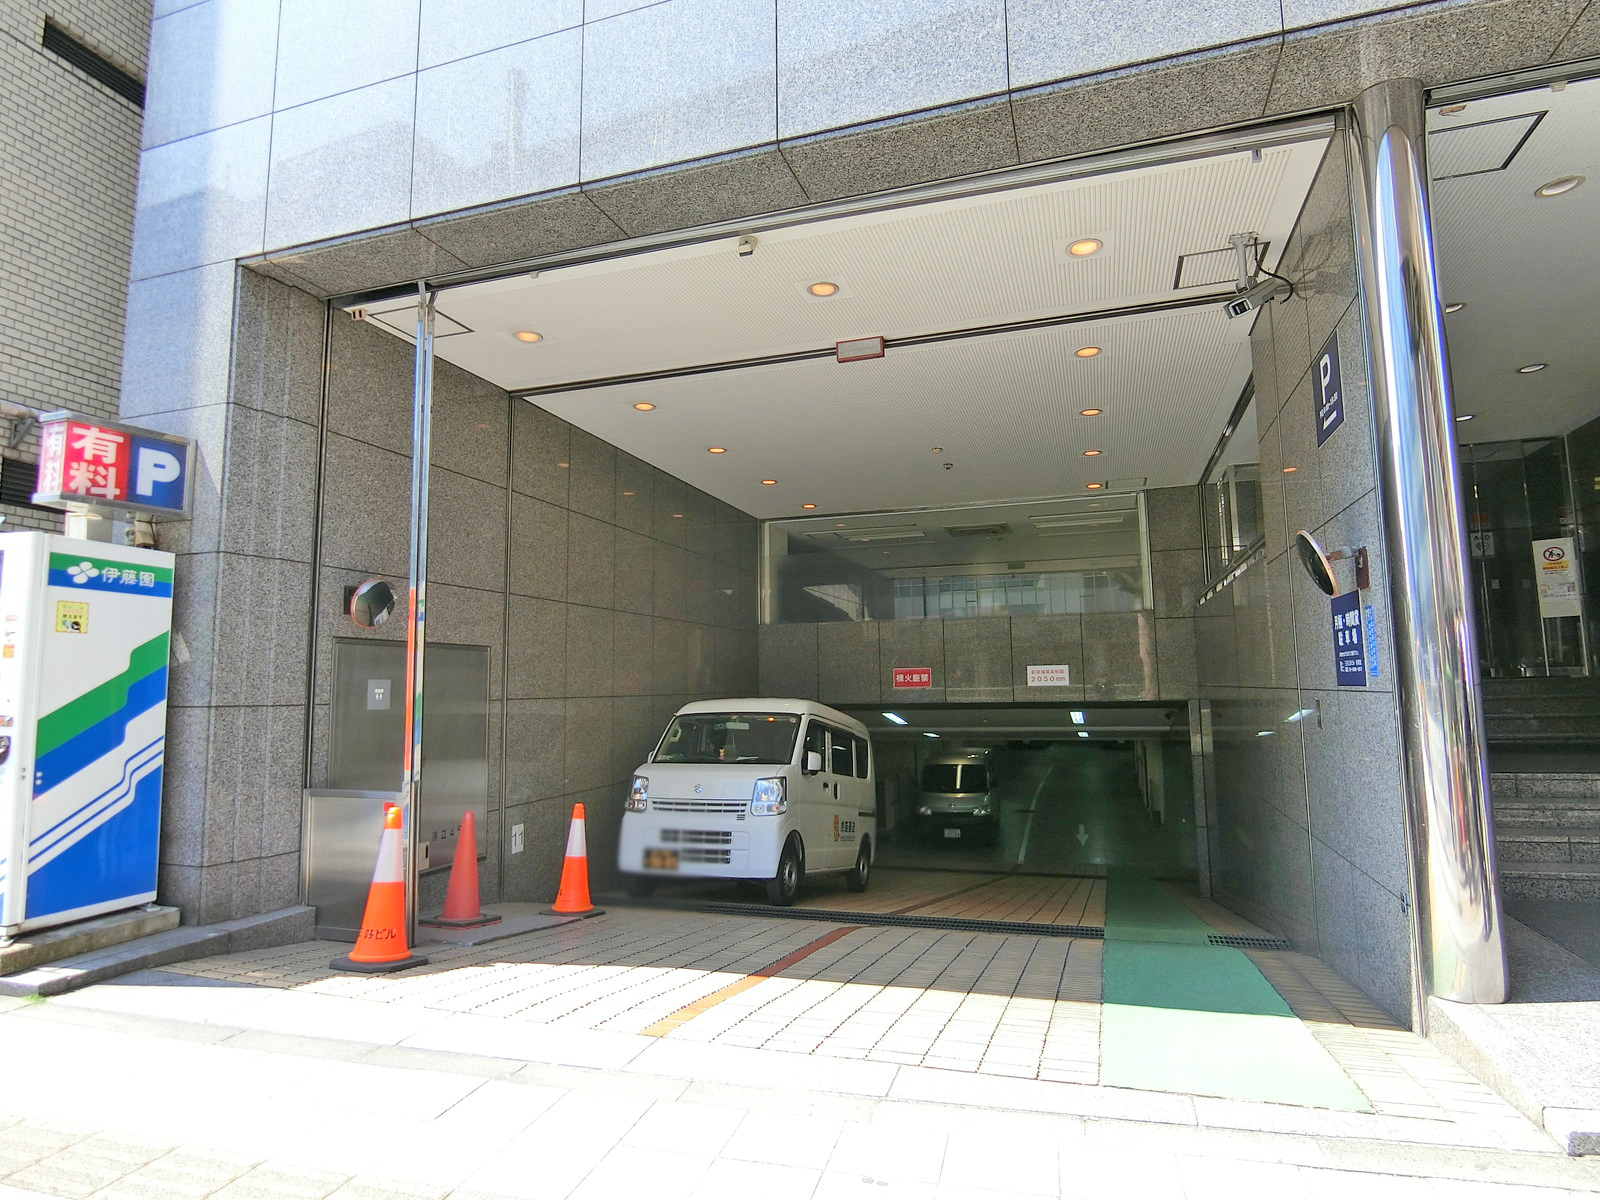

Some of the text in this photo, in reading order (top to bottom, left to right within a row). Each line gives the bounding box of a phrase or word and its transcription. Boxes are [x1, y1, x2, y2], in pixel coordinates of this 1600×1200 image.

[1319, 353, 1331, 406] P
[68, 427, 124, 500] 有料
[136, 447, 181, 497] P
[101, 566, 155, 588] 伊藤園
[896, 673, 929, 683] 裸火厳禁
[511, 830, 524, 848] 11
